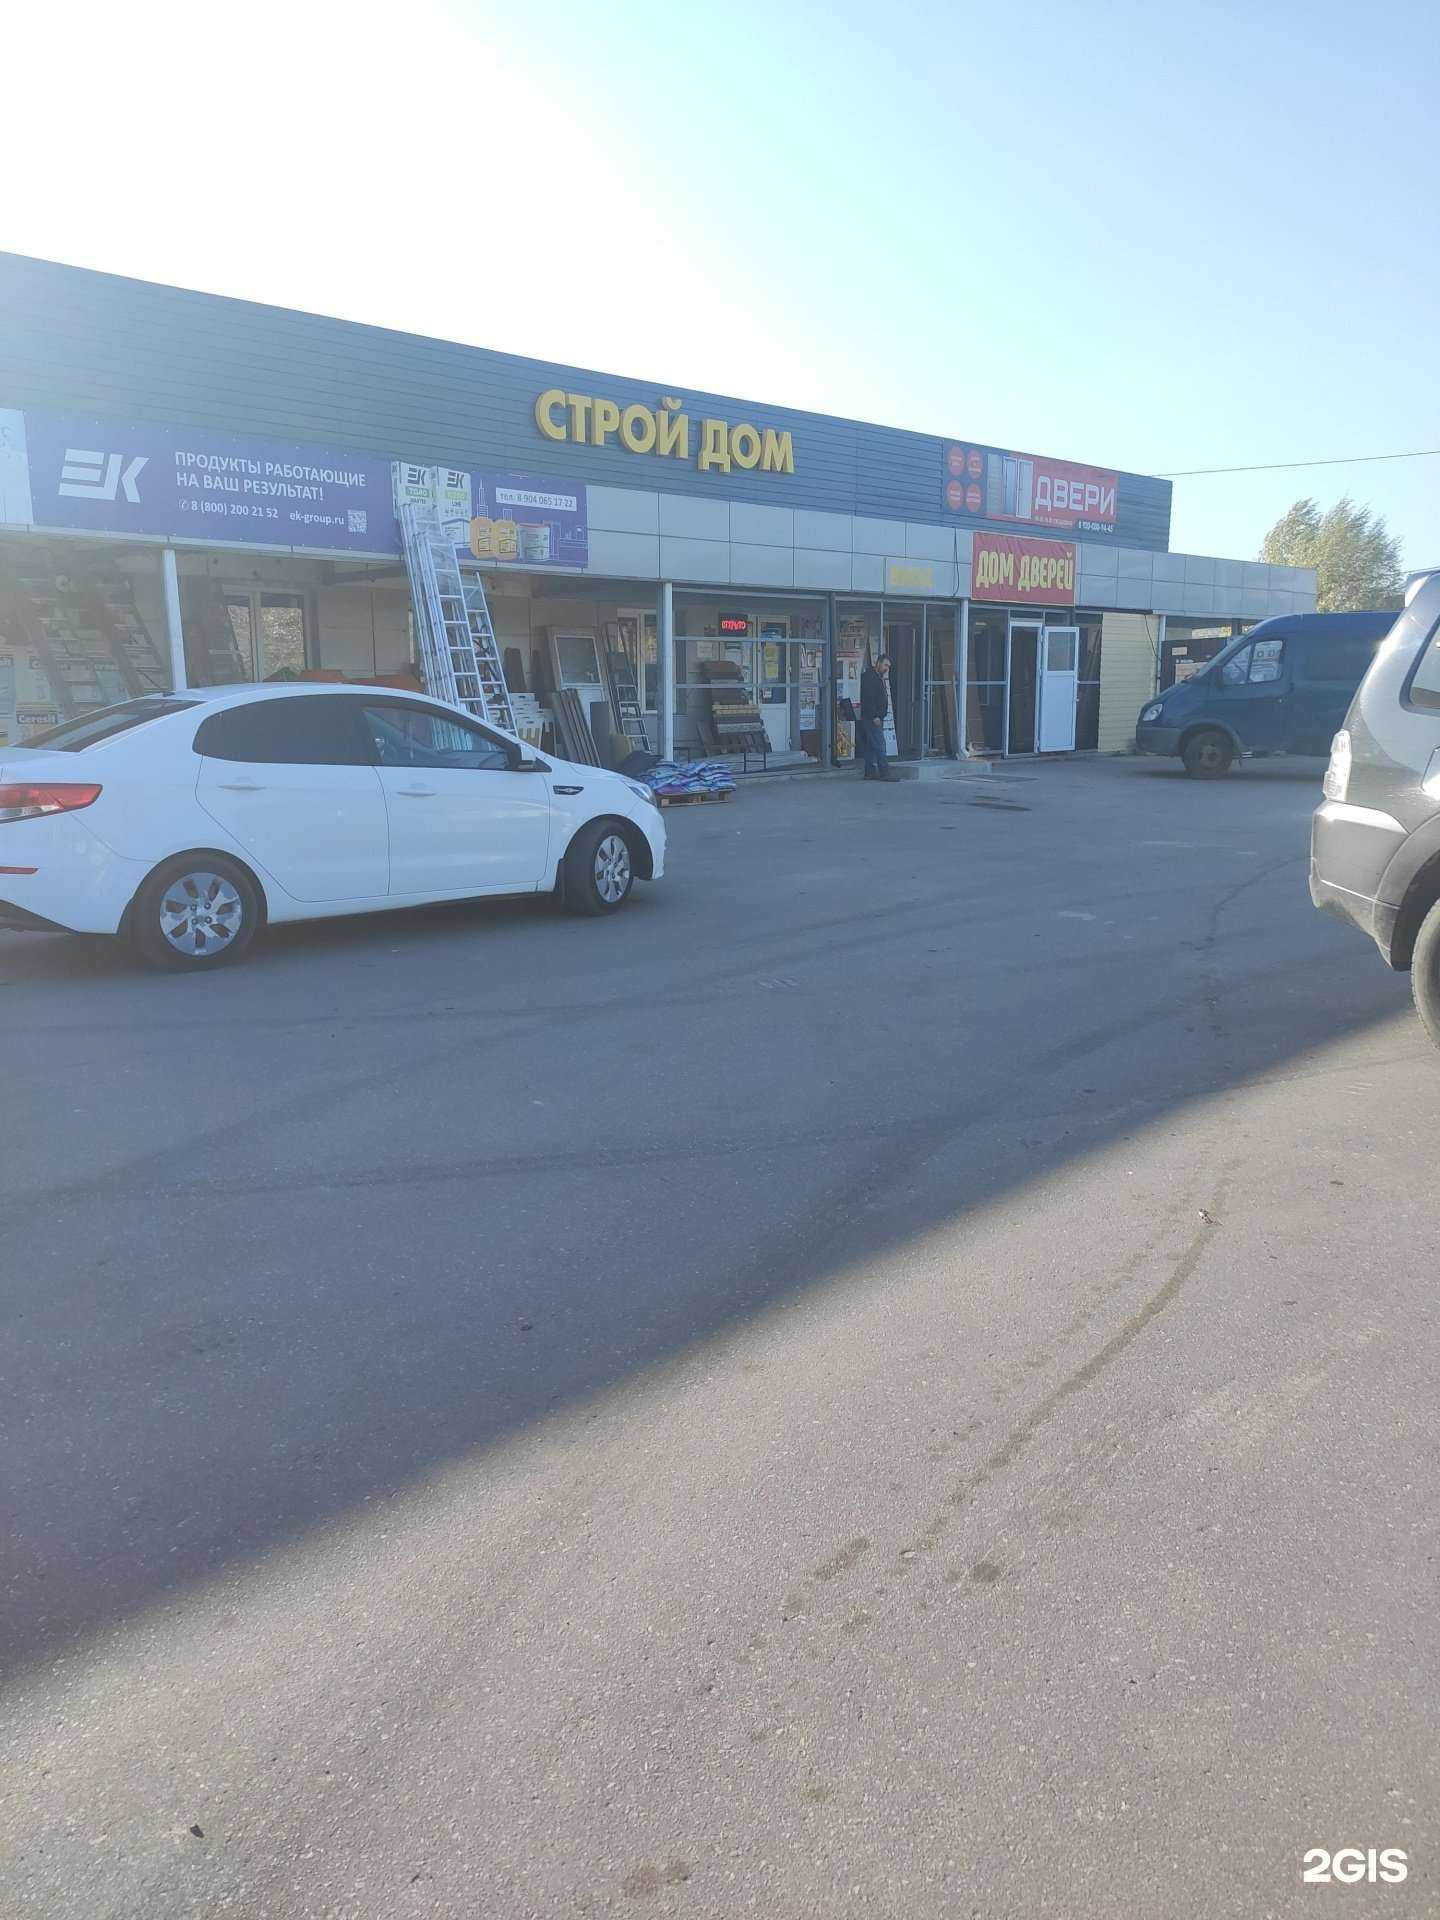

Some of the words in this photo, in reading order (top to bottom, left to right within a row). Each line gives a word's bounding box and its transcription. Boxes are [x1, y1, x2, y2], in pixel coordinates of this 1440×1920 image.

[535, 389, 689, 459] СТРОЙ
[698, 418, 795, 473] ДОМ
[175, 451, 261, 475] ПРОДУКТЫ
[265, 462, 366, 488] РАБОТАЮЩИЕ
[176, 472, 200, 488] НА
[203, 475, 239, 492] ВАШ
[243, 479, 324, 501] РЕЗУЛЬТАТ!
[191, 500, 198, 512] 8
[201, 501, 228, 516] (800)
[231, 504, 249, 517] 200
[252, 506, 264, 518] 21
[266, 507, 279, 519] 52
[289, 511, 345, 526] ek-group.ru
[538, 496, 553, 506] 065
[1034, 475, 1115, 517] ДВЕРИ
[975, 550, 1014, 588] ДОМ
[1018, 551, 1073, 592] ДВЕРЕЙ
